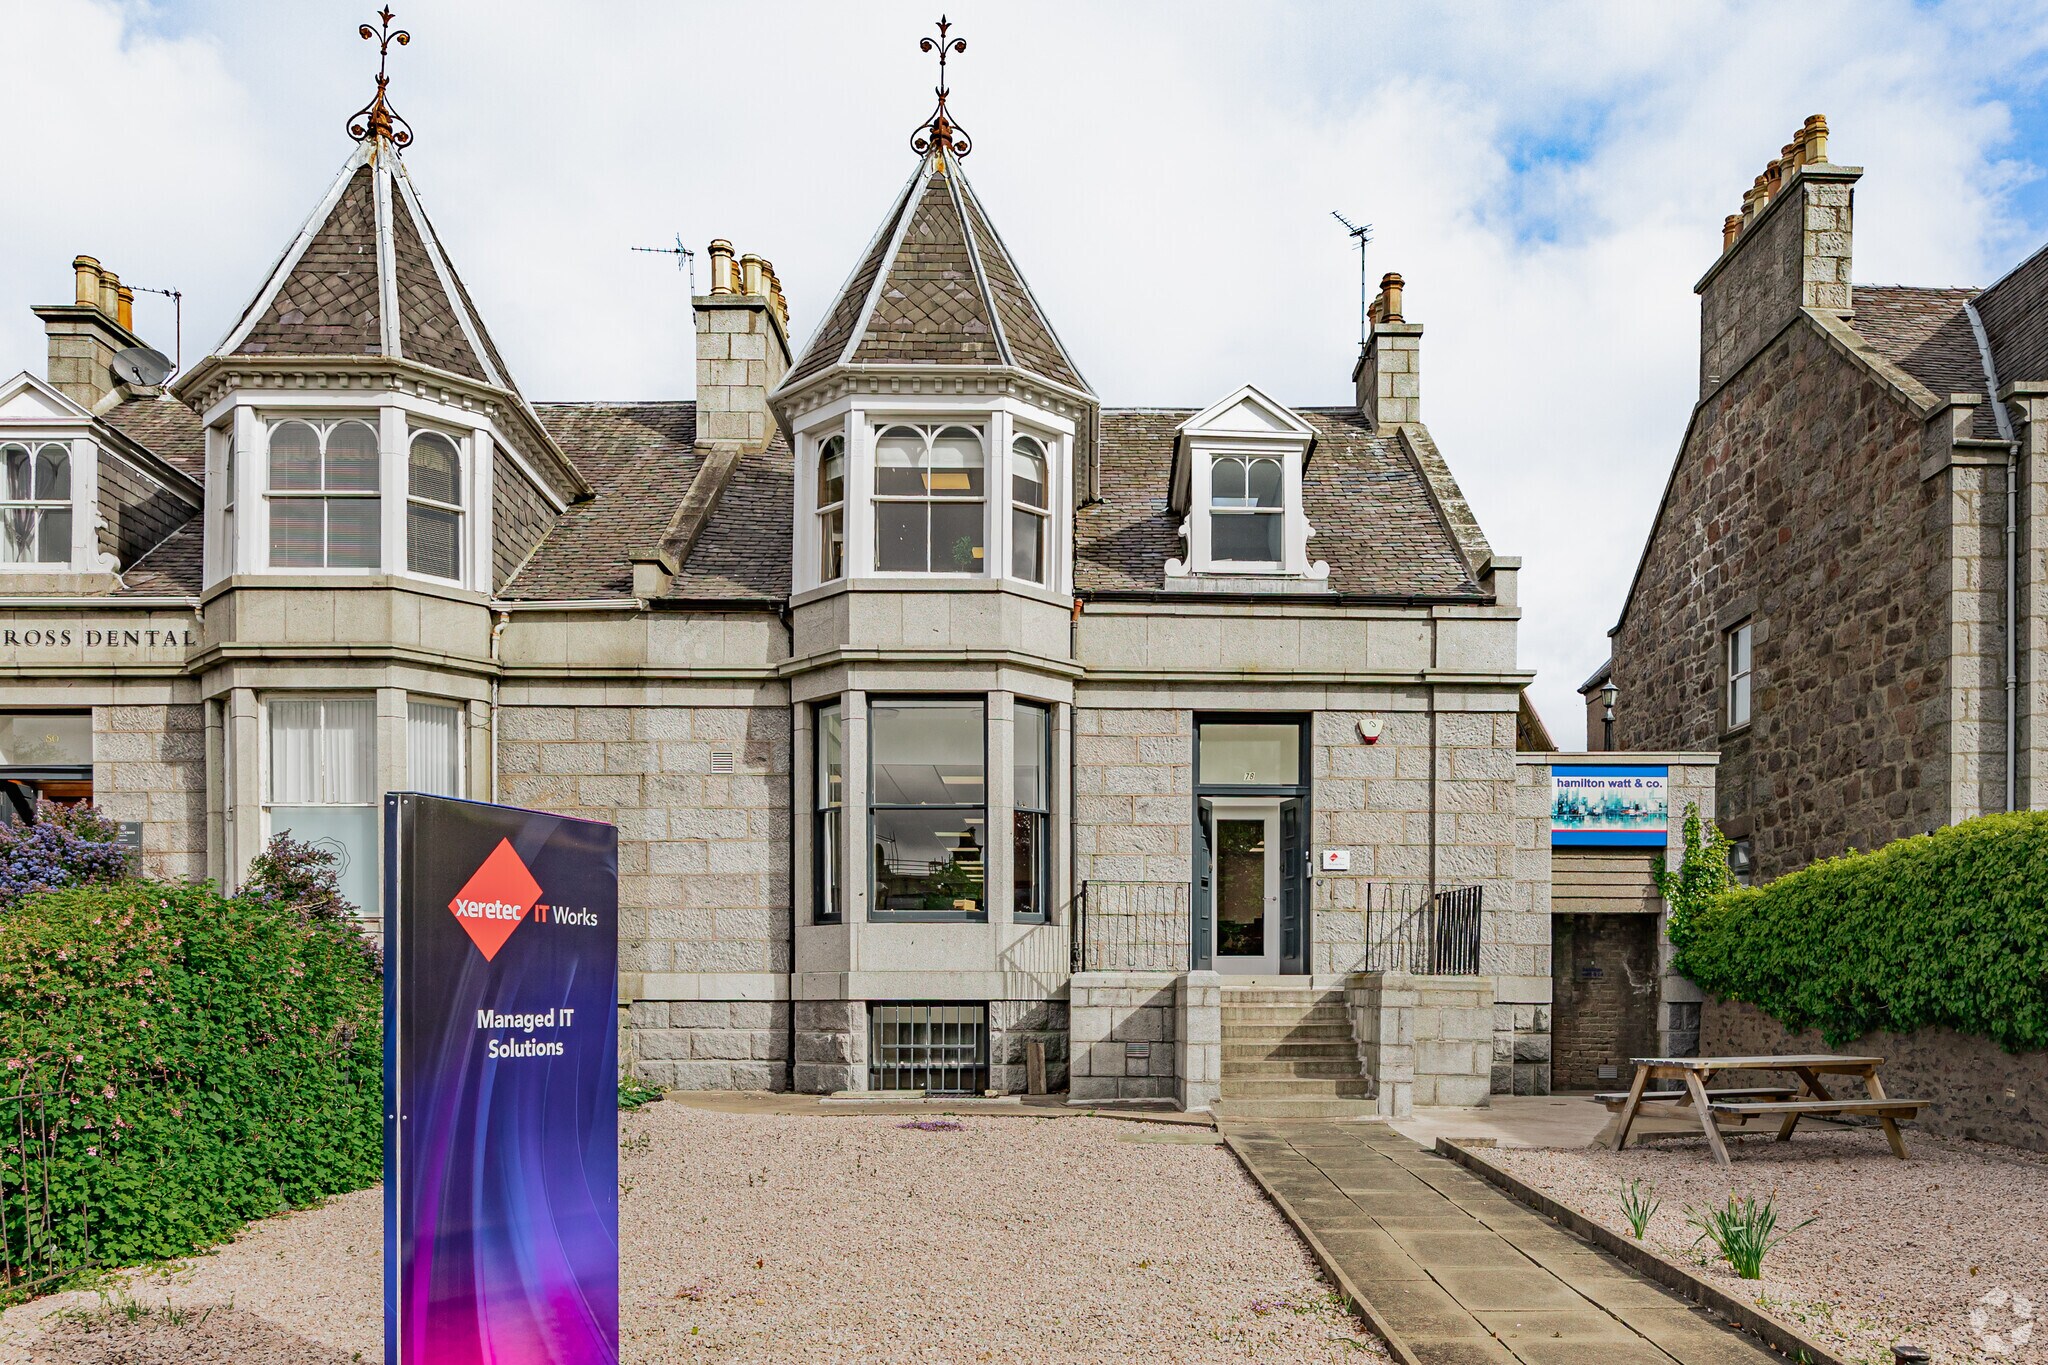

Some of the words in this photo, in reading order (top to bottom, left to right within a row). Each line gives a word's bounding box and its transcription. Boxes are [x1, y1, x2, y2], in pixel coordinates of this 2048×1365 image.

[3, 629, 71, 647] ROSS
[86, 629, 196, 647] DENTAL
[1557, 778, 1605, 788] hamilton
[1608, 779, 1631, 788] watt
[1634, 779, 1643, 788] &
[455, 898, 521, 921] Xeretec
[534, 904, 549, 923] IT
[552, 906, 598, 926] Works
[477, 1008, 554, 1033] Managed
[559, 1008, 574, 1027] IT
[488, 1038, 563, 1058] Solutions
